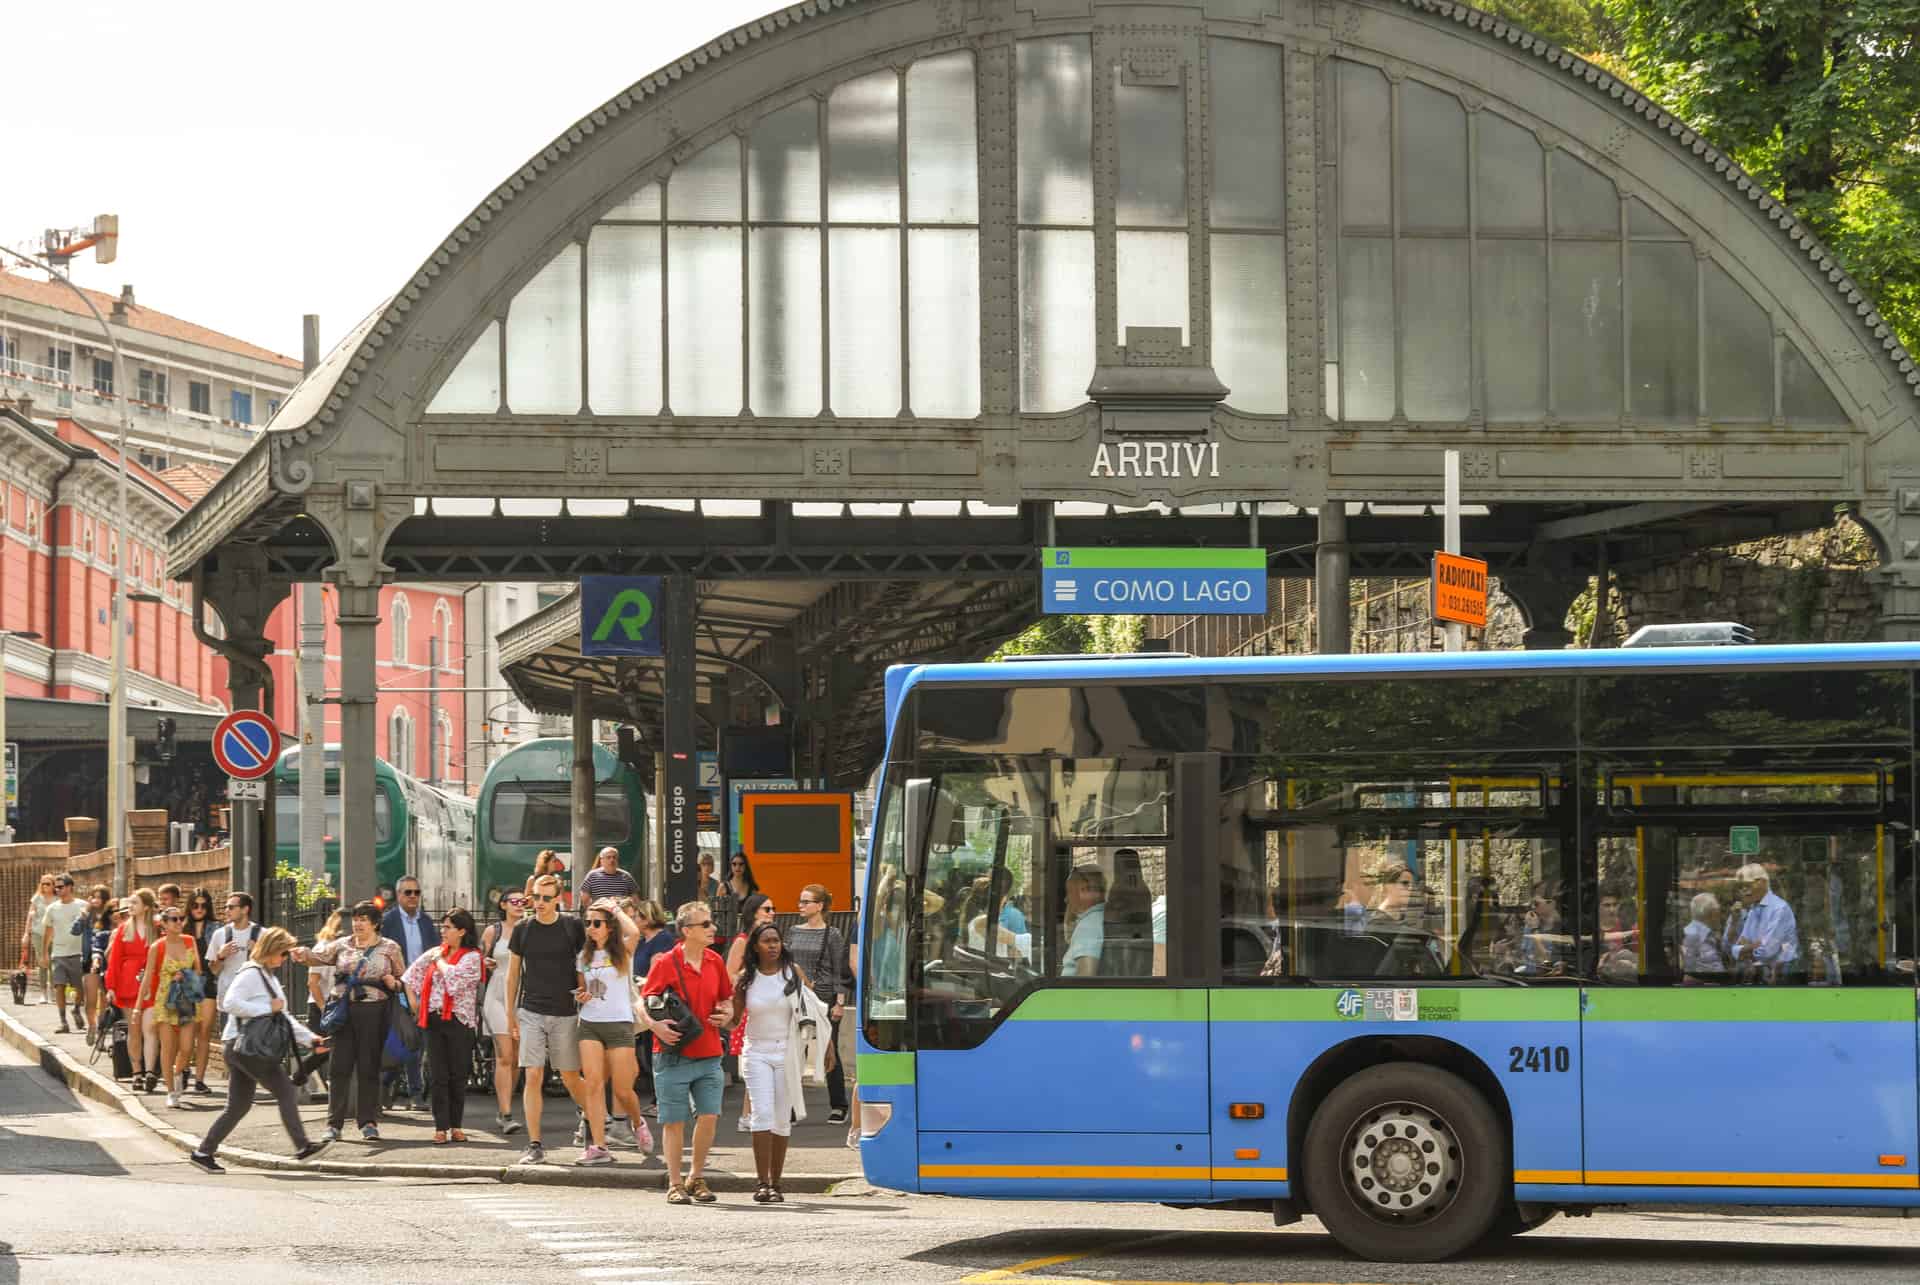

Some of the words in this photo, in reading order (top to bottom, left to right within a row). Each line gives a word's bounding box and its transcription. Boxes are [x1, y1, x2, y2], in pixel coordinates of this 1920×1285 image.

[1090, 441, 1220, 477] ARRIVI
[1093, 580, 1175, 601] COMO
[1183, 580, 1251, 601] LAGO
[1439, 563, 1485, 592] RADIOTAXI
[591, 588, 652, 641] R
[706, 765, 719, 784] 2
[671, 786, 686, 824] Lago
[671, 829, 684, 874] Como
[1509, 1046, 1570, 1072] 2410
